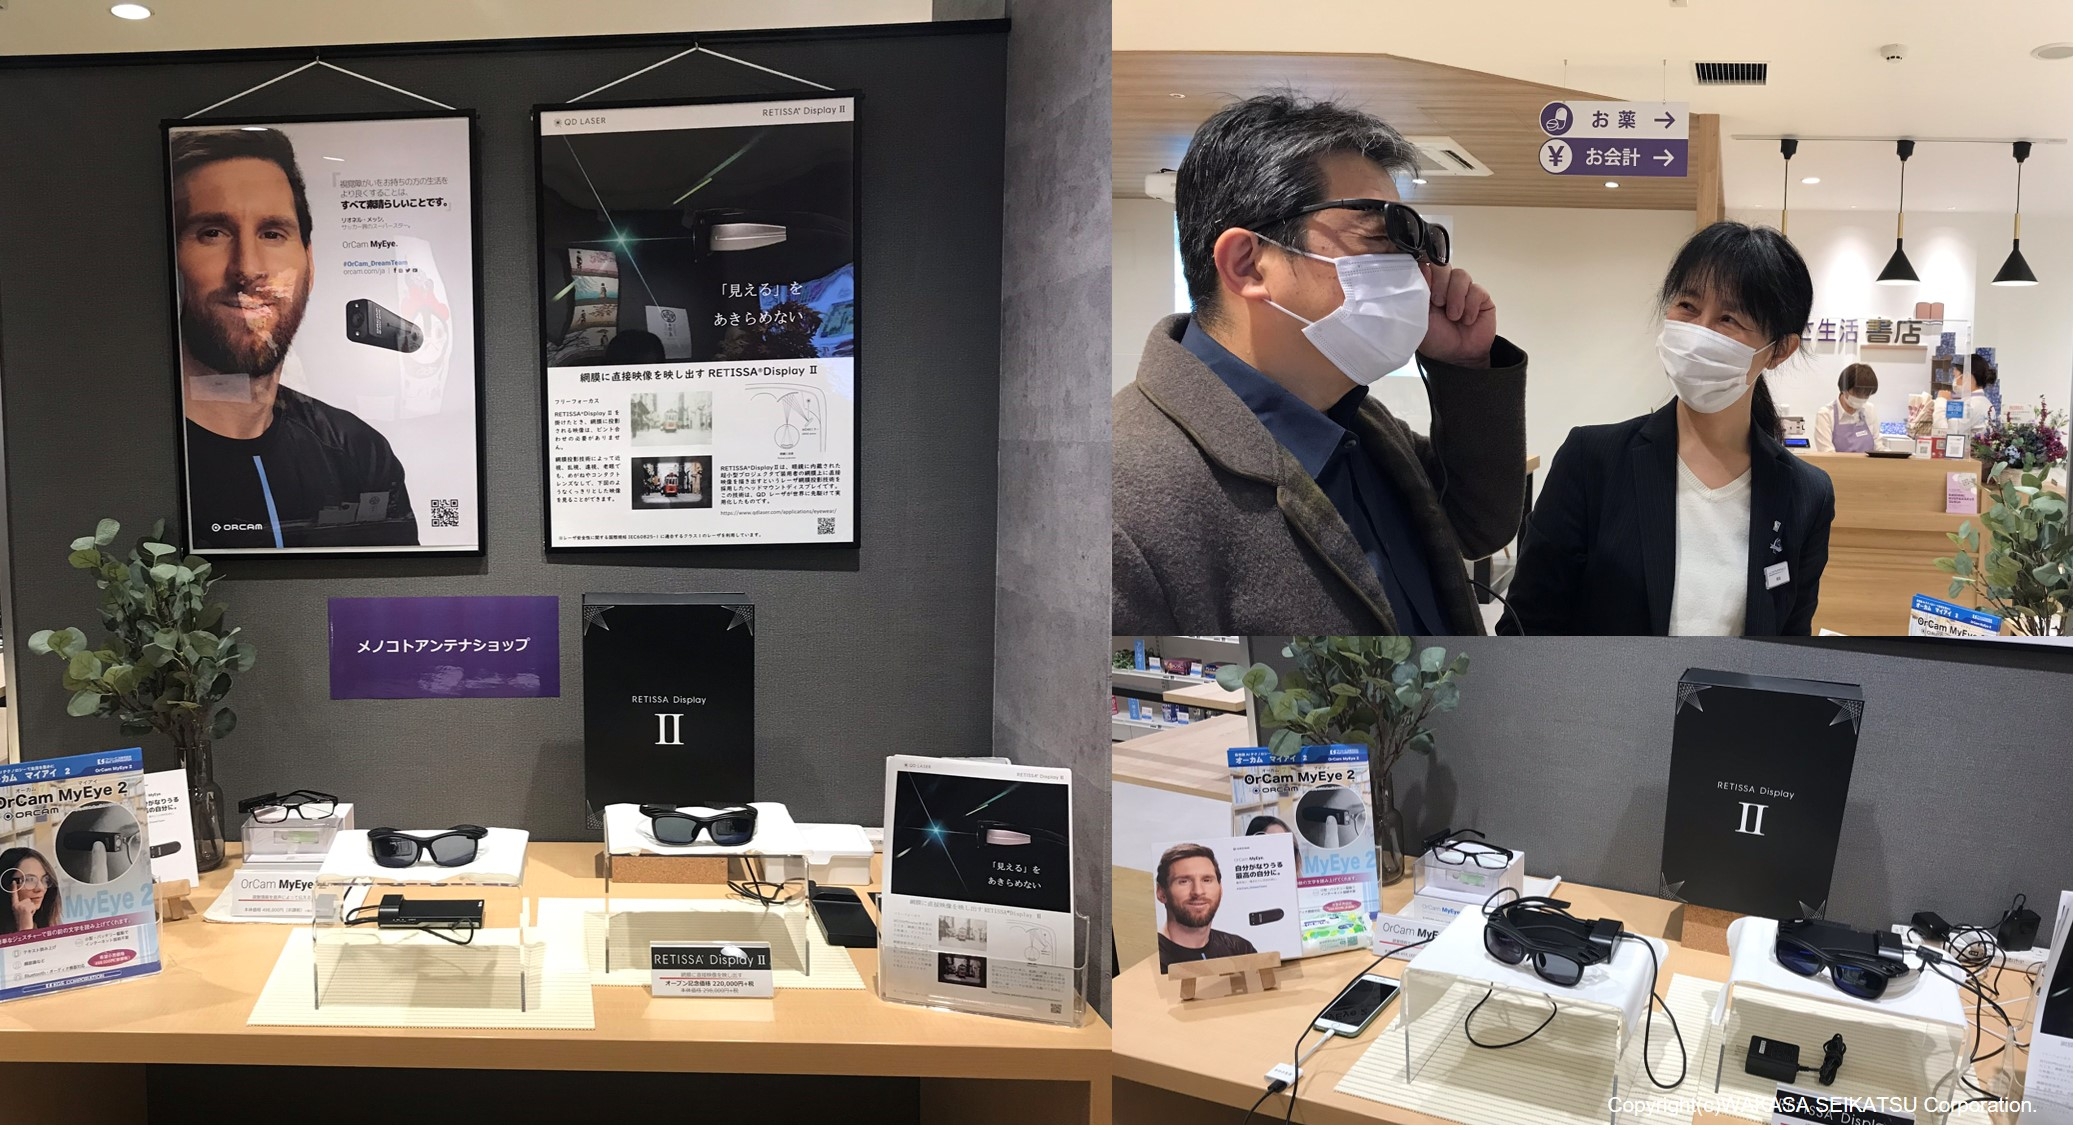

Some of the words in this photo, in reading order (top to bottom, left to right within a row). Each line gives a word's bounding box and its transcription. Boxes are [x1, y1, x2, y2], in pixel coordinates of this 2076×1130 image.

[803, 105, 836, 116] Display
[564, 118, 578, 126] QD
[580, 116, 606, 126] LASER
[1585, 147, 1641, 167] お会計
[342, 241, 369, 249] OrCam
[370, 240, 398, 249] MyEye.
[343, 259, 408, 267] #OrCam_DreamTeam
[343, 266, 386, 275] orcam.com/ja
[721, 281, 803, 299] 「見える」を
[713, 310, 804, 328] あきらめない
[1865, 317, 1923, 345] 書店
[579, 368, 705, 384] 網膜に直接映像を映し出す
[555, 434, 620, 442] わせの必要がありませ
[556, 471, 620, 479] も、めがねやコンタクト
[557, 487, 621, 495] うなくっきりとした映像
[223, 523, 263, 531] ORCAM
[1917, 616, 1948, 633] OrCam
[357, 636, 531, 654] メノコトアンテナショップ
[632, 695, 669, 704] RETISSA
[673, 695, 706, 706] Display
[1235, 756, 1264, 764] オーカム
[1269, 754, 1297, 762] マイアイ
[25, 769, 58, 780] マイアイ
[64, 767, 71, 775] 2
[1244, 773, 1294, 785] OrCam
[1297, 770, 1343, 784] MyEye
[1346, 769, 1355, 780] 2
[58, 786, 113, 802] MyEye
[117, 781, 128, 794] 2
[1717, 780, 1755, 794] RETISSA
[1759, 787, 1795, 801] Display
[15, 807, 59, 819] ORCAM
[992, 860, 1041, 875] 「見える」を
[1235, 861, 1284, 872] 自分がなりうる
[1303, 853, 1361, 876] MyEye
[1235, 868, 1281, 880] 最高の自分に。
[241, 878, 276, 889] OrCam
[278, 879, 314, 891] MyEye
[987, 876, 1042, 890] あきらめない
[65, 890, 135, 920] MyEye
[140, 883, 154, 906] 2
[1382, 922, 1415, 936] OrCam
